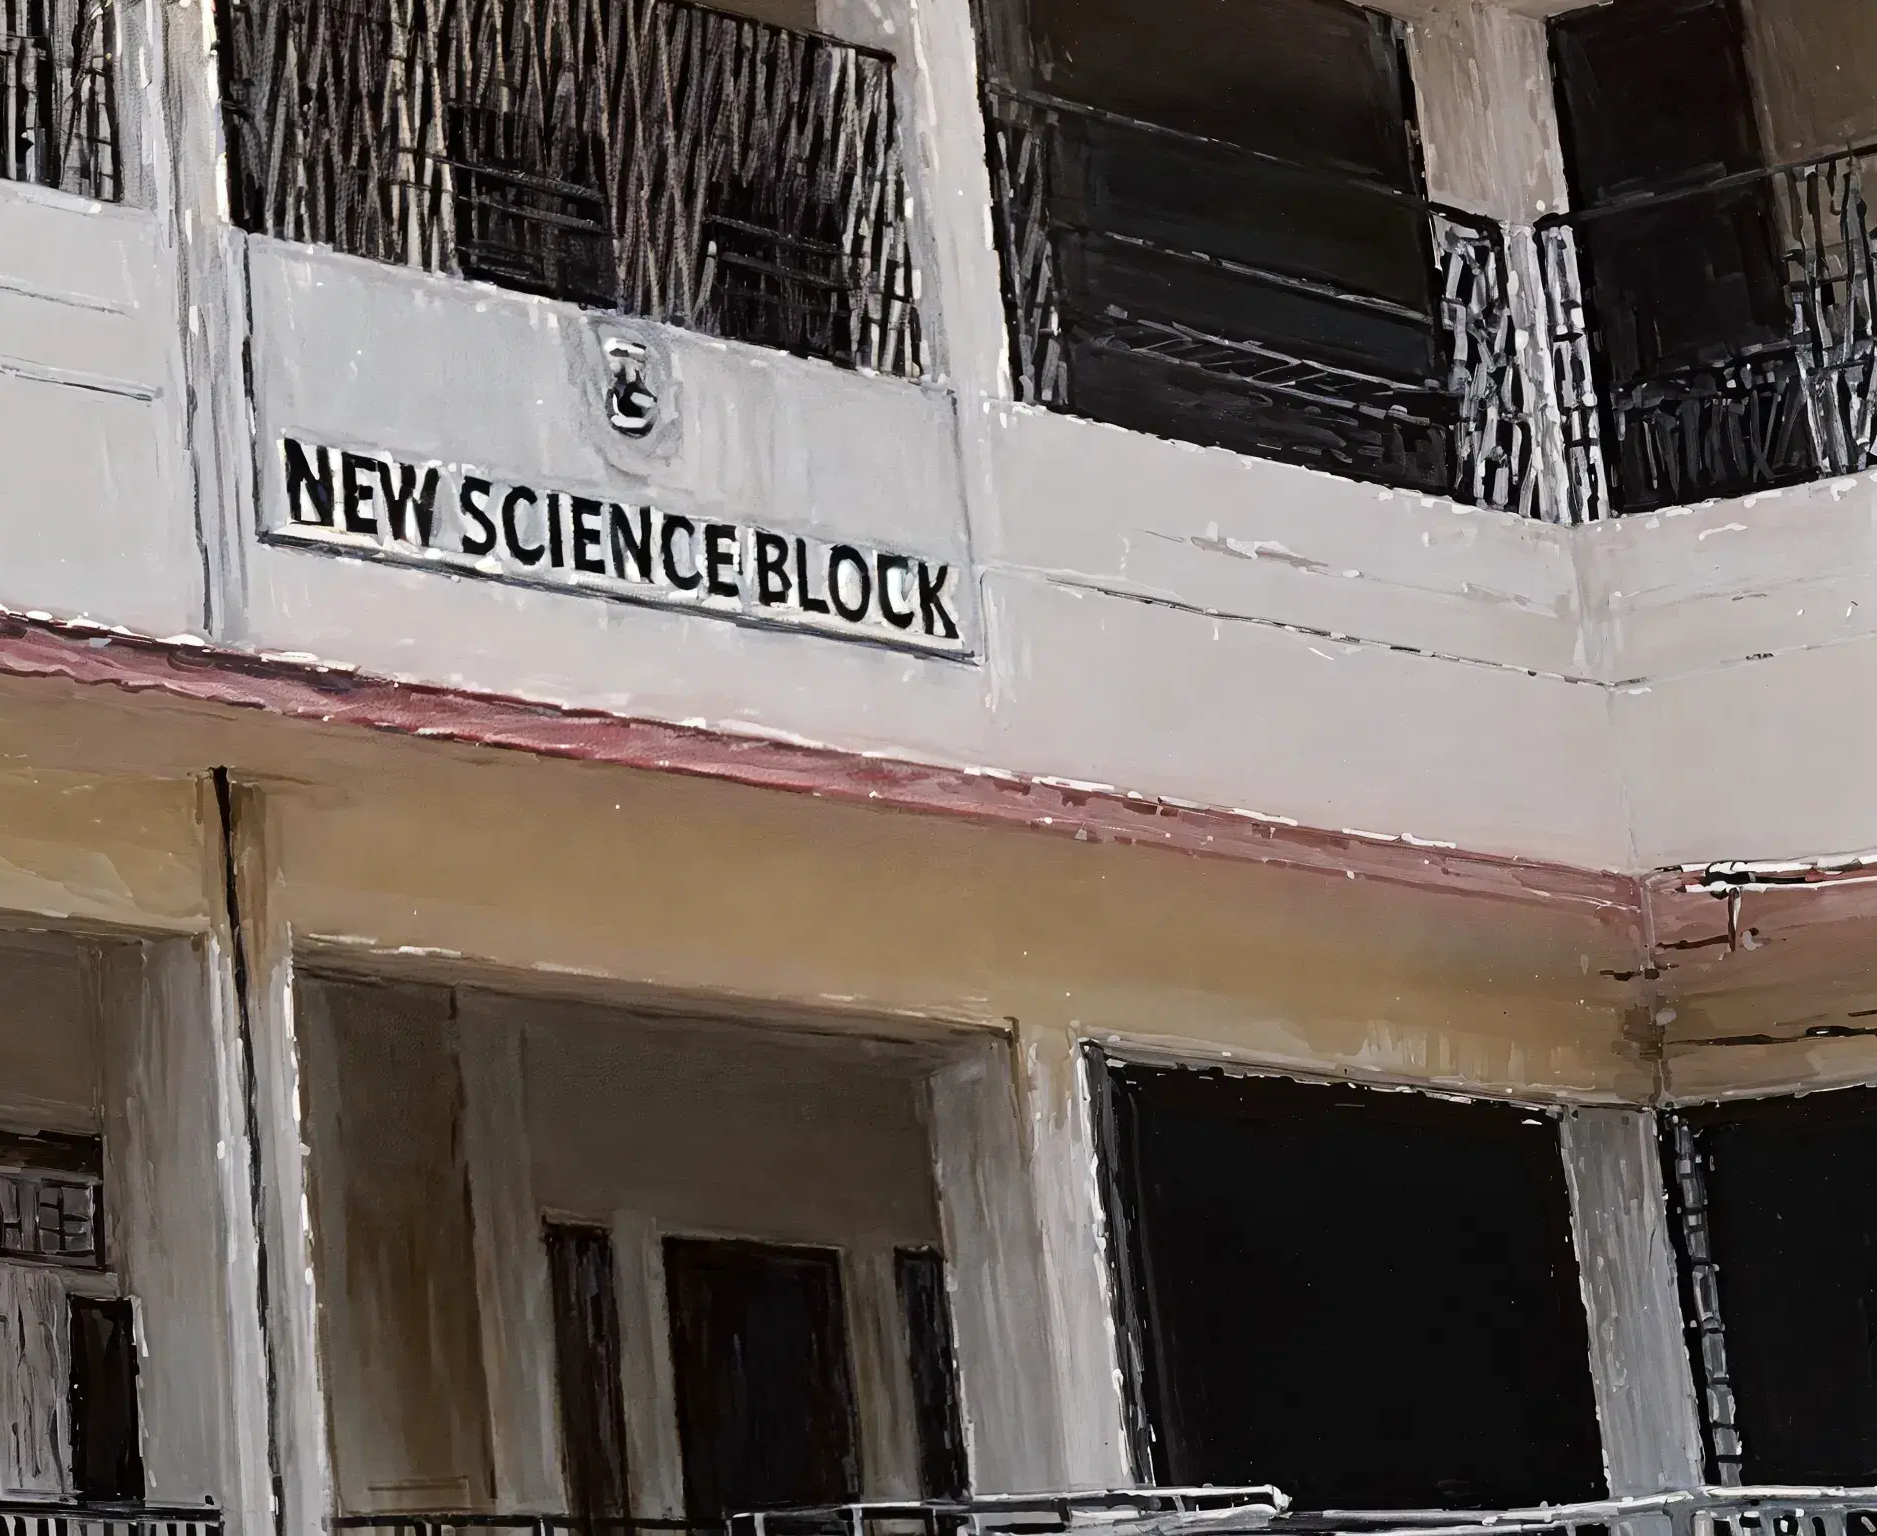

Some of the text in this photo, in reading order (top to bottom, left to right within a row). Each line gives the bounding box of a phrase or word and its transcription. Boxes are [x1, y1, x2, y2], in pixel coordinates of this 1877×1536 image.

[282, 437, 959, 639] NEW SCIENCE BLOCK
